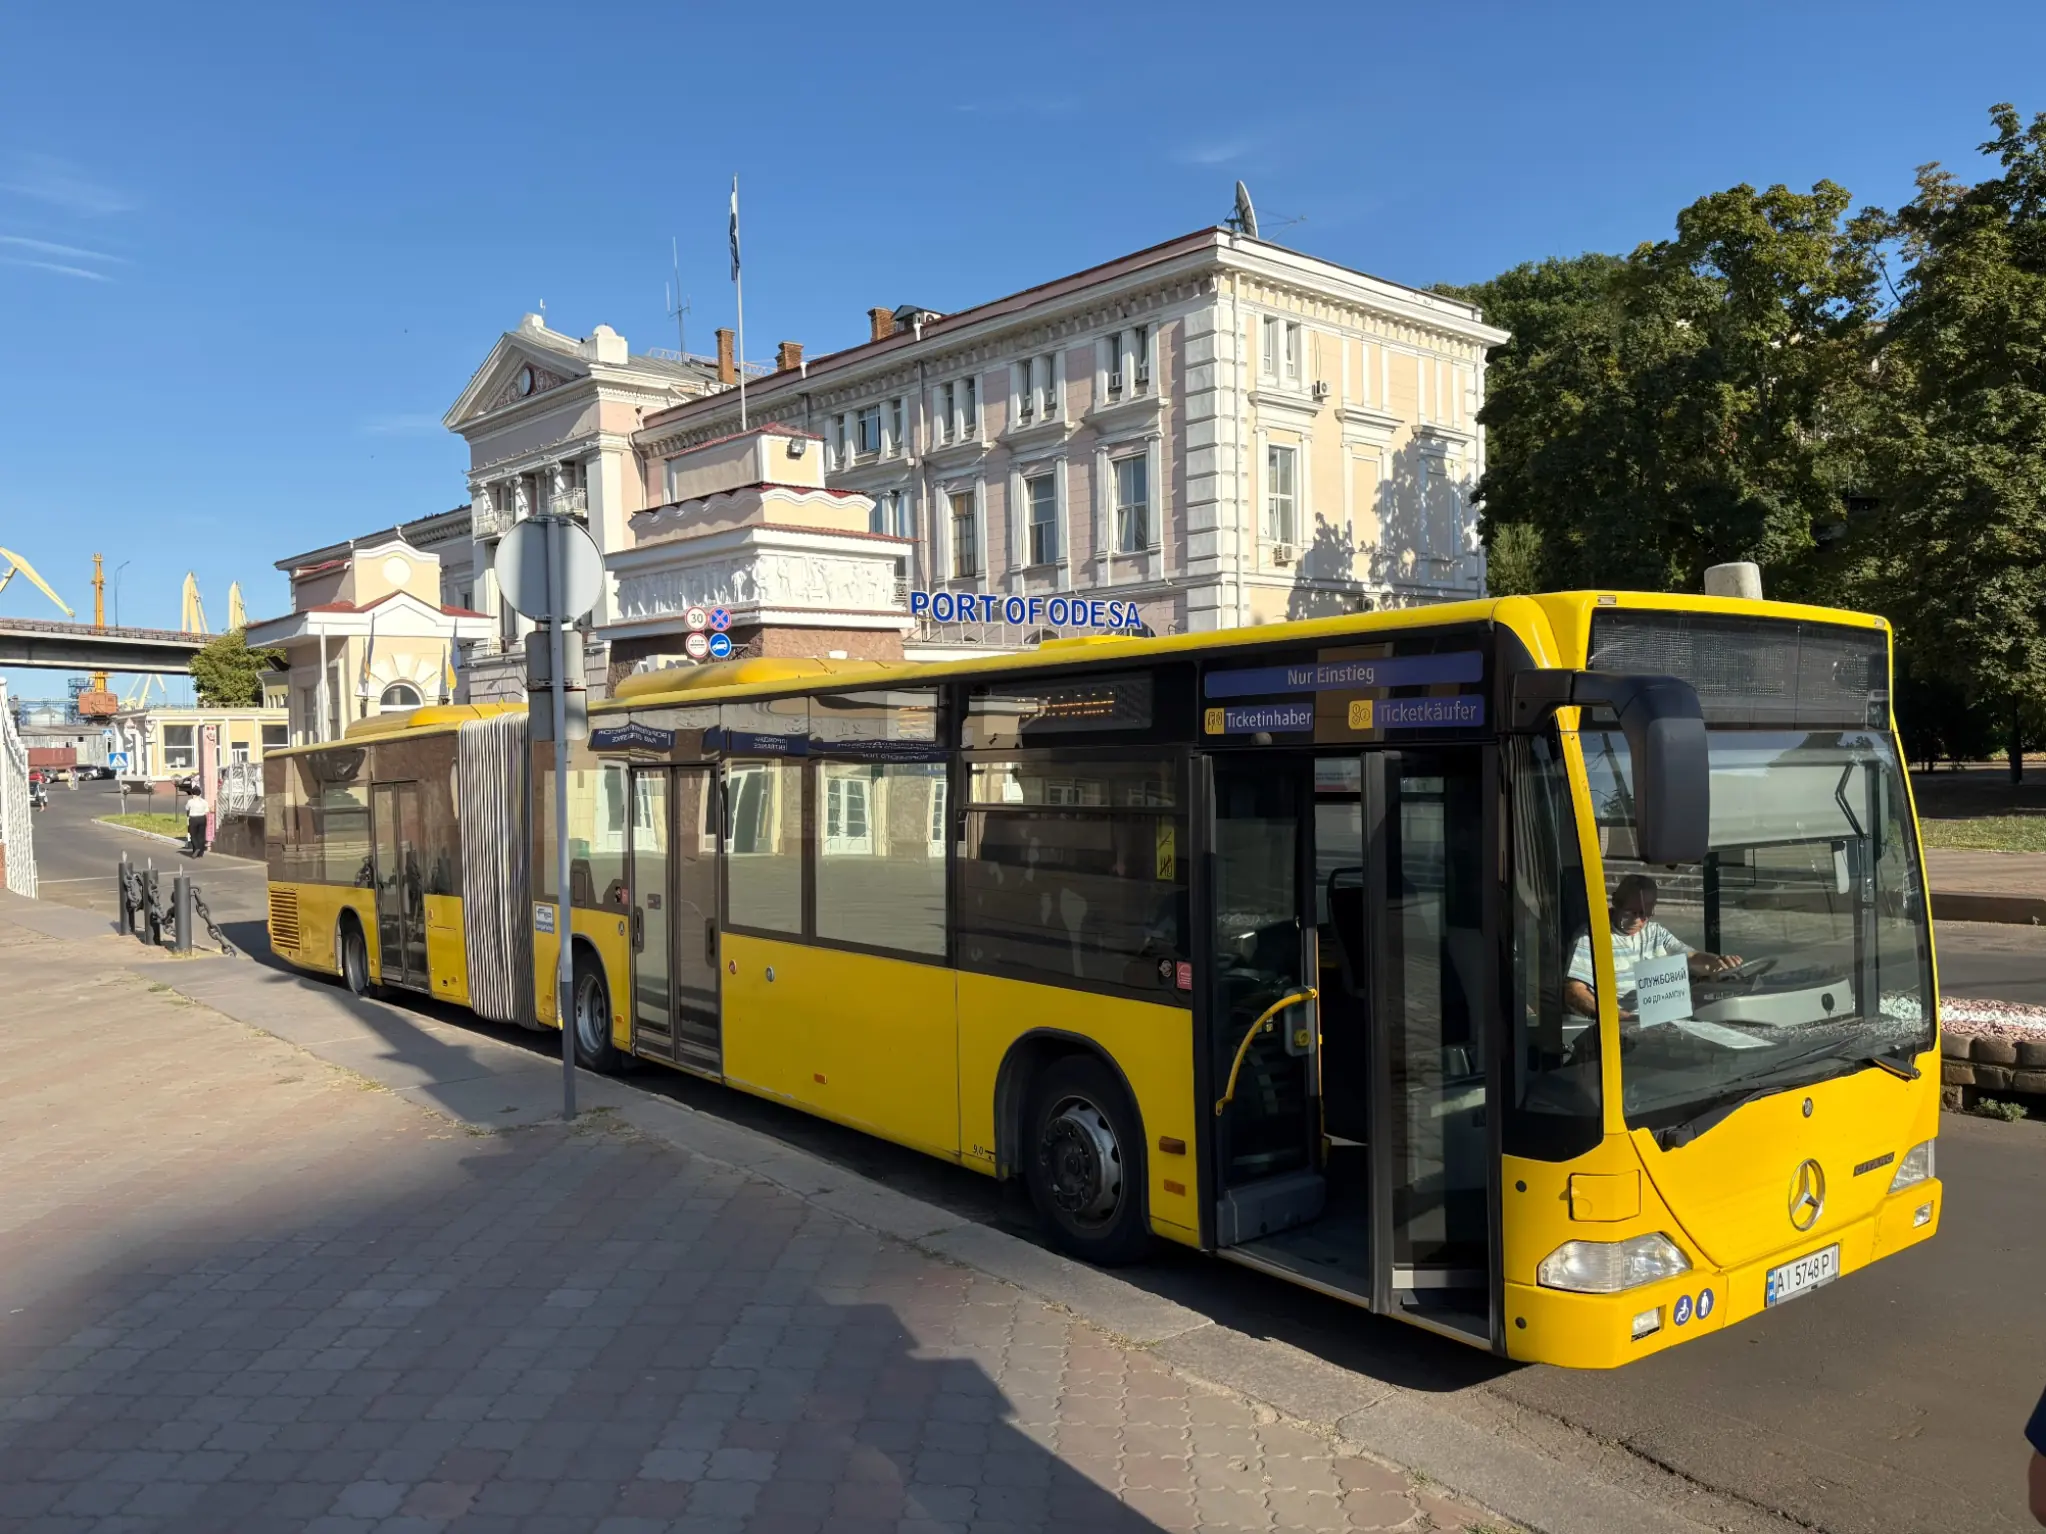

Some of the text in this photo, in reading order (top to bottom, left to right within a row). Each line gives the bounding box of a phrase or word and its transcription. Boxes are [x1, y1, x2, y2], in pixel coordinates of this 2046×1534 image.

[690, 613, 704, 624] 30
[910, 591, 1142, 629] PORT OF ODESA
[1287, 664, 1375, 686] Nur Einstieg
[1225, 710, 1312, 729] Ticketinhaber
[1378, 701, 1477, 723] Ticketkäufer
[1638, 968, 1687, 989] СЛУЖБОВИЙ
[1855, 1154, 1894, 1175] CITARO
[1777, 1268, 1791, 1294] AI
[1795, 1258, 1820, 1286] 5748
